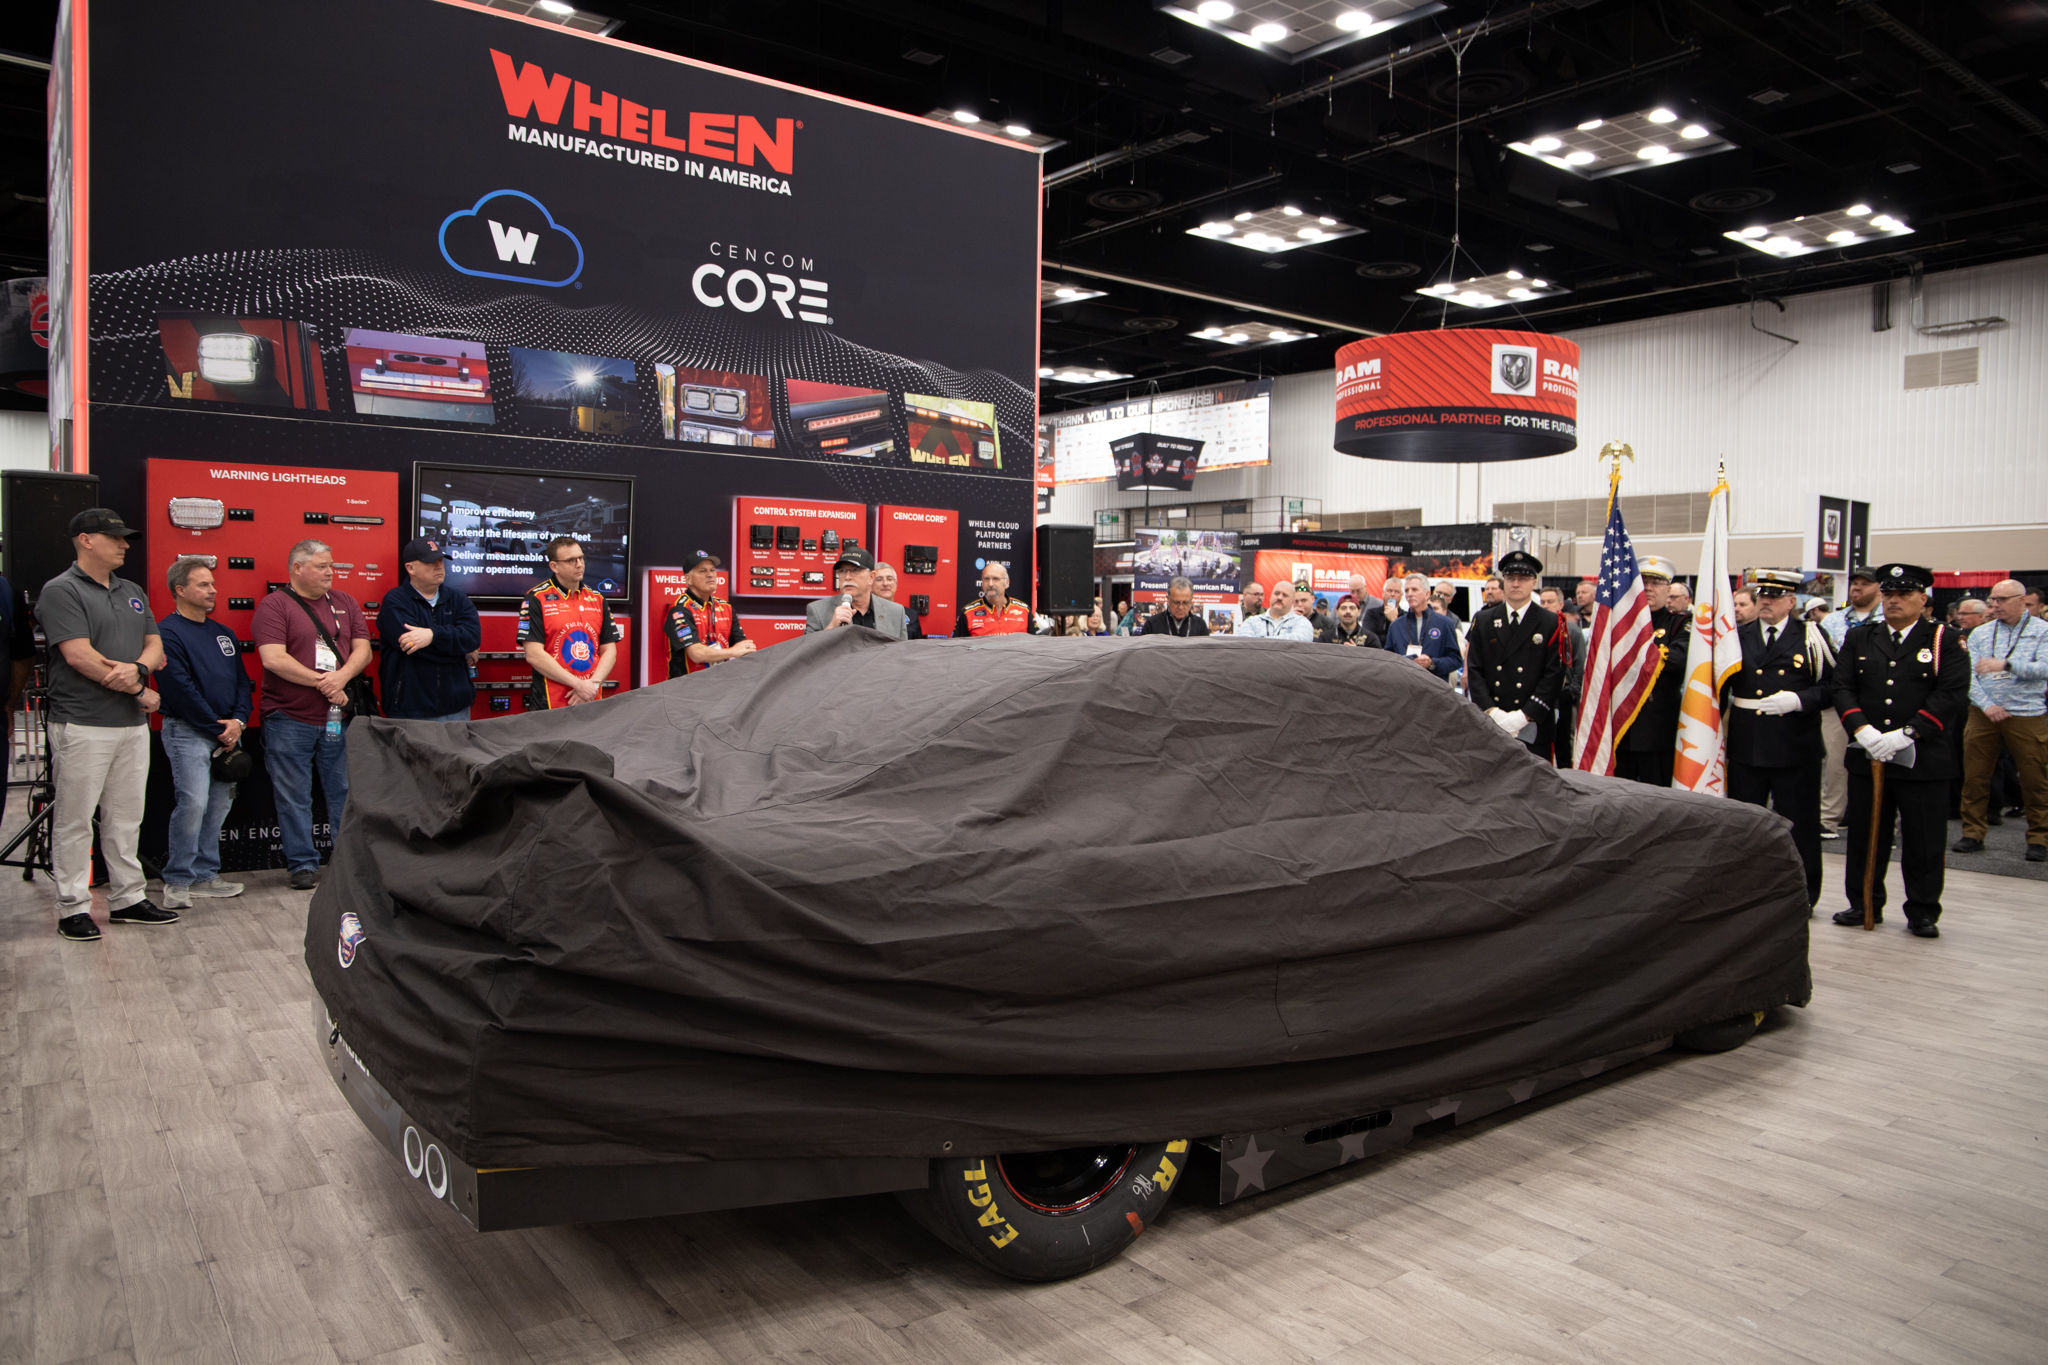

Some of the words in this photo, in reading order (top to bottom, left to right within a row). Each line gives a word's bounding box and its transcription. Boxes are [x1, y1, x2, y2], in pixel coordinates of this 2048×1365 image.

[508, 123, 679, 172] MANUFACTURED
[684, 160, 704, 178] IN
[708, 166, 793, 196] AMERICA
[710, 242, 814, 272] CENCOM
[1337, 359, 1381, 387] RAM
[1053, 415, 1085, 427] THANK
[1087, 409, 1107, 422] YOU
[1109, 406, 1124, 418] TO
[1127, 402, 1149, 417] OUR
[1355, 414, 1437, 430] PROFESSIONAL
[1441, 413, 1502, 425] PARTNER
[1504, 415, 1528, 428] FOR
[1530, 418, 1550, 430] THE
[1551, 421, 1575, 437] FUTURE
[210, 468, 270, 482] WARNING
[272, 472, 347, 486] LIGHTHEADS
[452, 506, 490, 518] Improve
[492, 508, 535, 520] efficiency
[754, 506, 788, 516] CONTROL
[789, 508, 817, 518] SYSTEM
[818, 510, 857, 520] EXPANSION
[894, 512, 924, 522] CENCOM
[968, 520, 996, 529] WHELEN
[998, 522, 1020, 530] CLOUD
[452, 528, 484, 538] Extend
[486, 529, 500, 538] the
[502, 530, 538, 542] lifespan
[540, 531, 550, 540] of
[572, 532, 591, 542] fleet
[978, 541, 1012, 550] PARTNERS
[452, 550, 485, 560] Deliver
[486, 552, 544, 562] measureable
[452, 564, 461, 574] to
[463, 566, 488, 576] your
[491, 566, 534, 576] operations
[1314, 570, 1350, 580] RAM
[655, 575, 686, 583] WHELE
[1220, 584, 1234, 592] Flag
[964, 1159, 1019, 1248] EAGL
